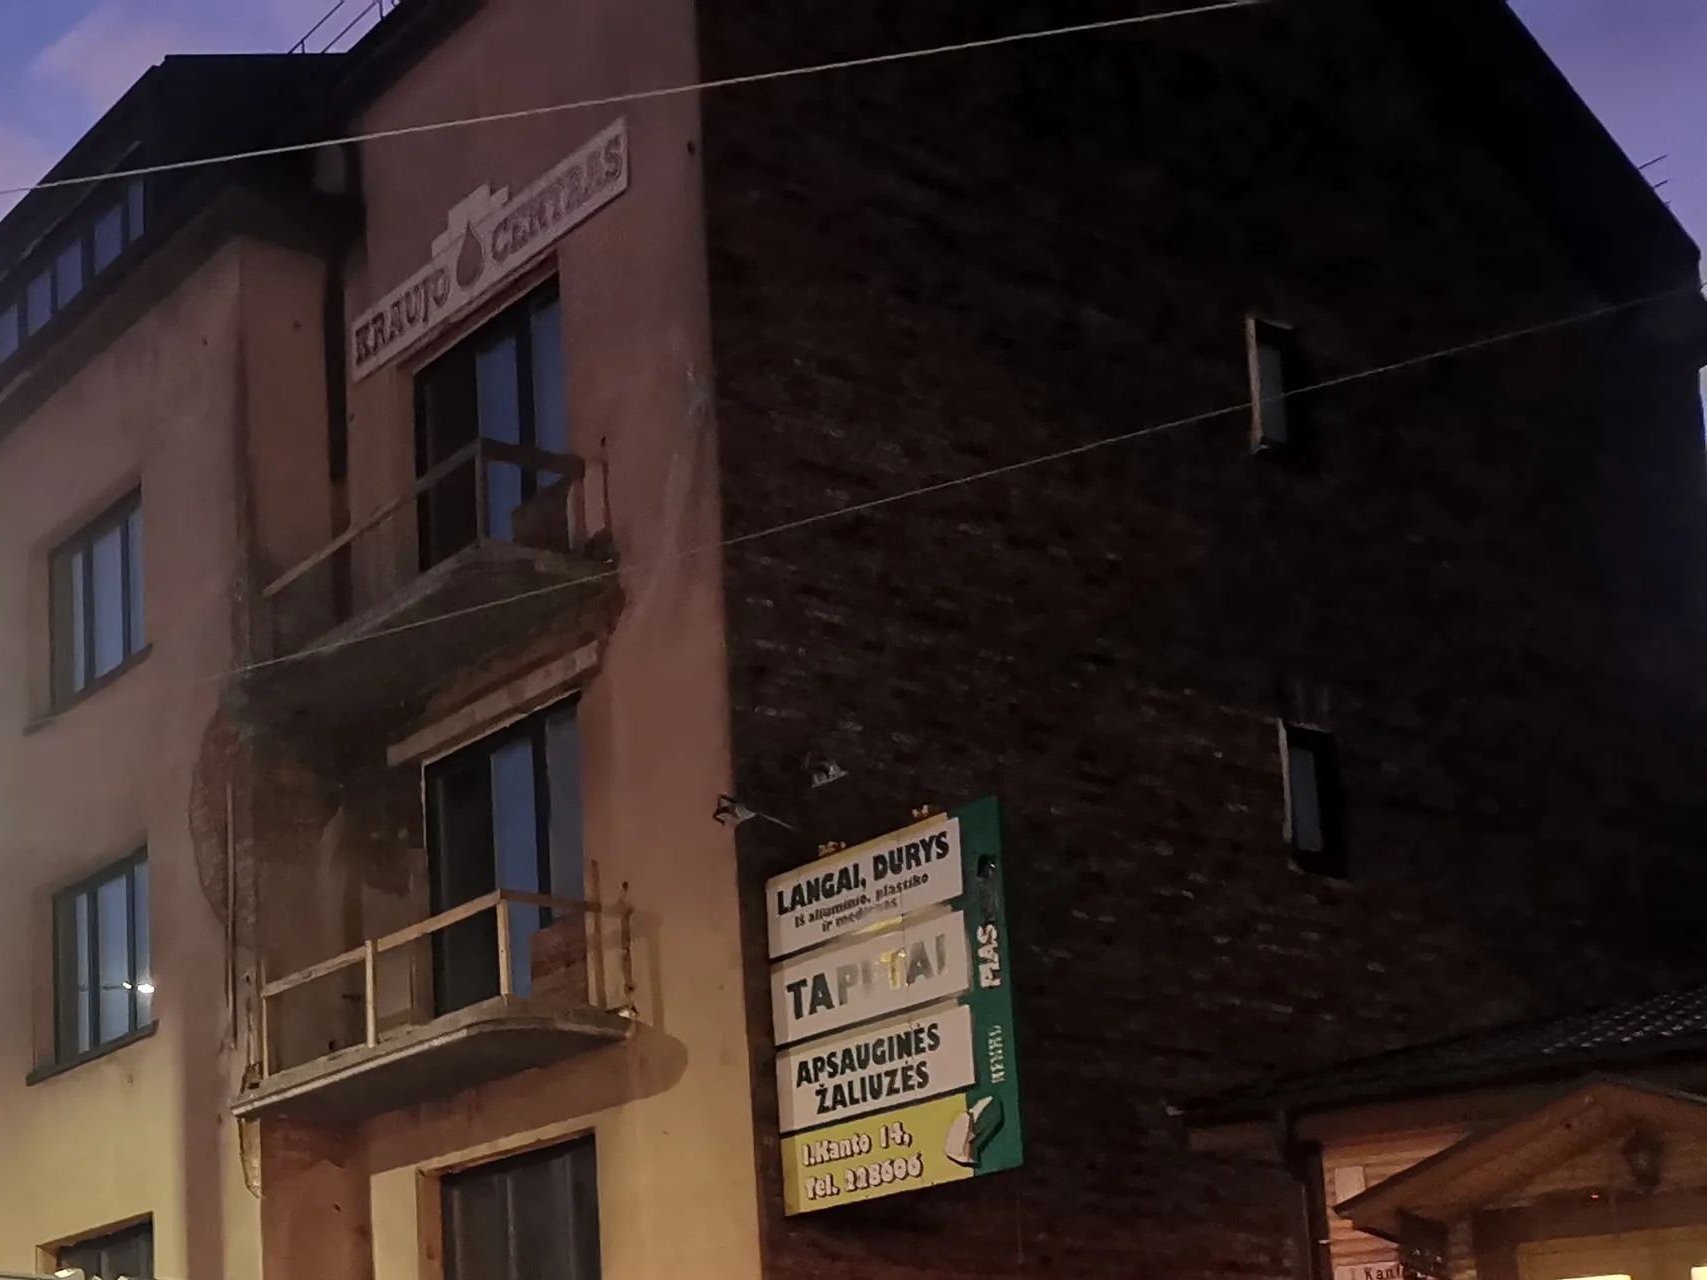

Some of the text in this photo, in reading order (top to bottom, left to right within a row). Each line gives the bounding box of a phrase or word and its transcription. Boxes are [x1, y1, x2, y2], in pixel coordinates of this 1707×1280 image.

[354, 266, 451, 367] KRAUJO
[777, 831, 950, 915] LANGAI, DURYS
[875, 872, 930, 900] plastiko
[796, 1022, 941, 1088] APSAUGINĖS
[815, 1060, 930, 1115] ŽALIUZĖS
[804, 1173, 840, 1200] Tel.
